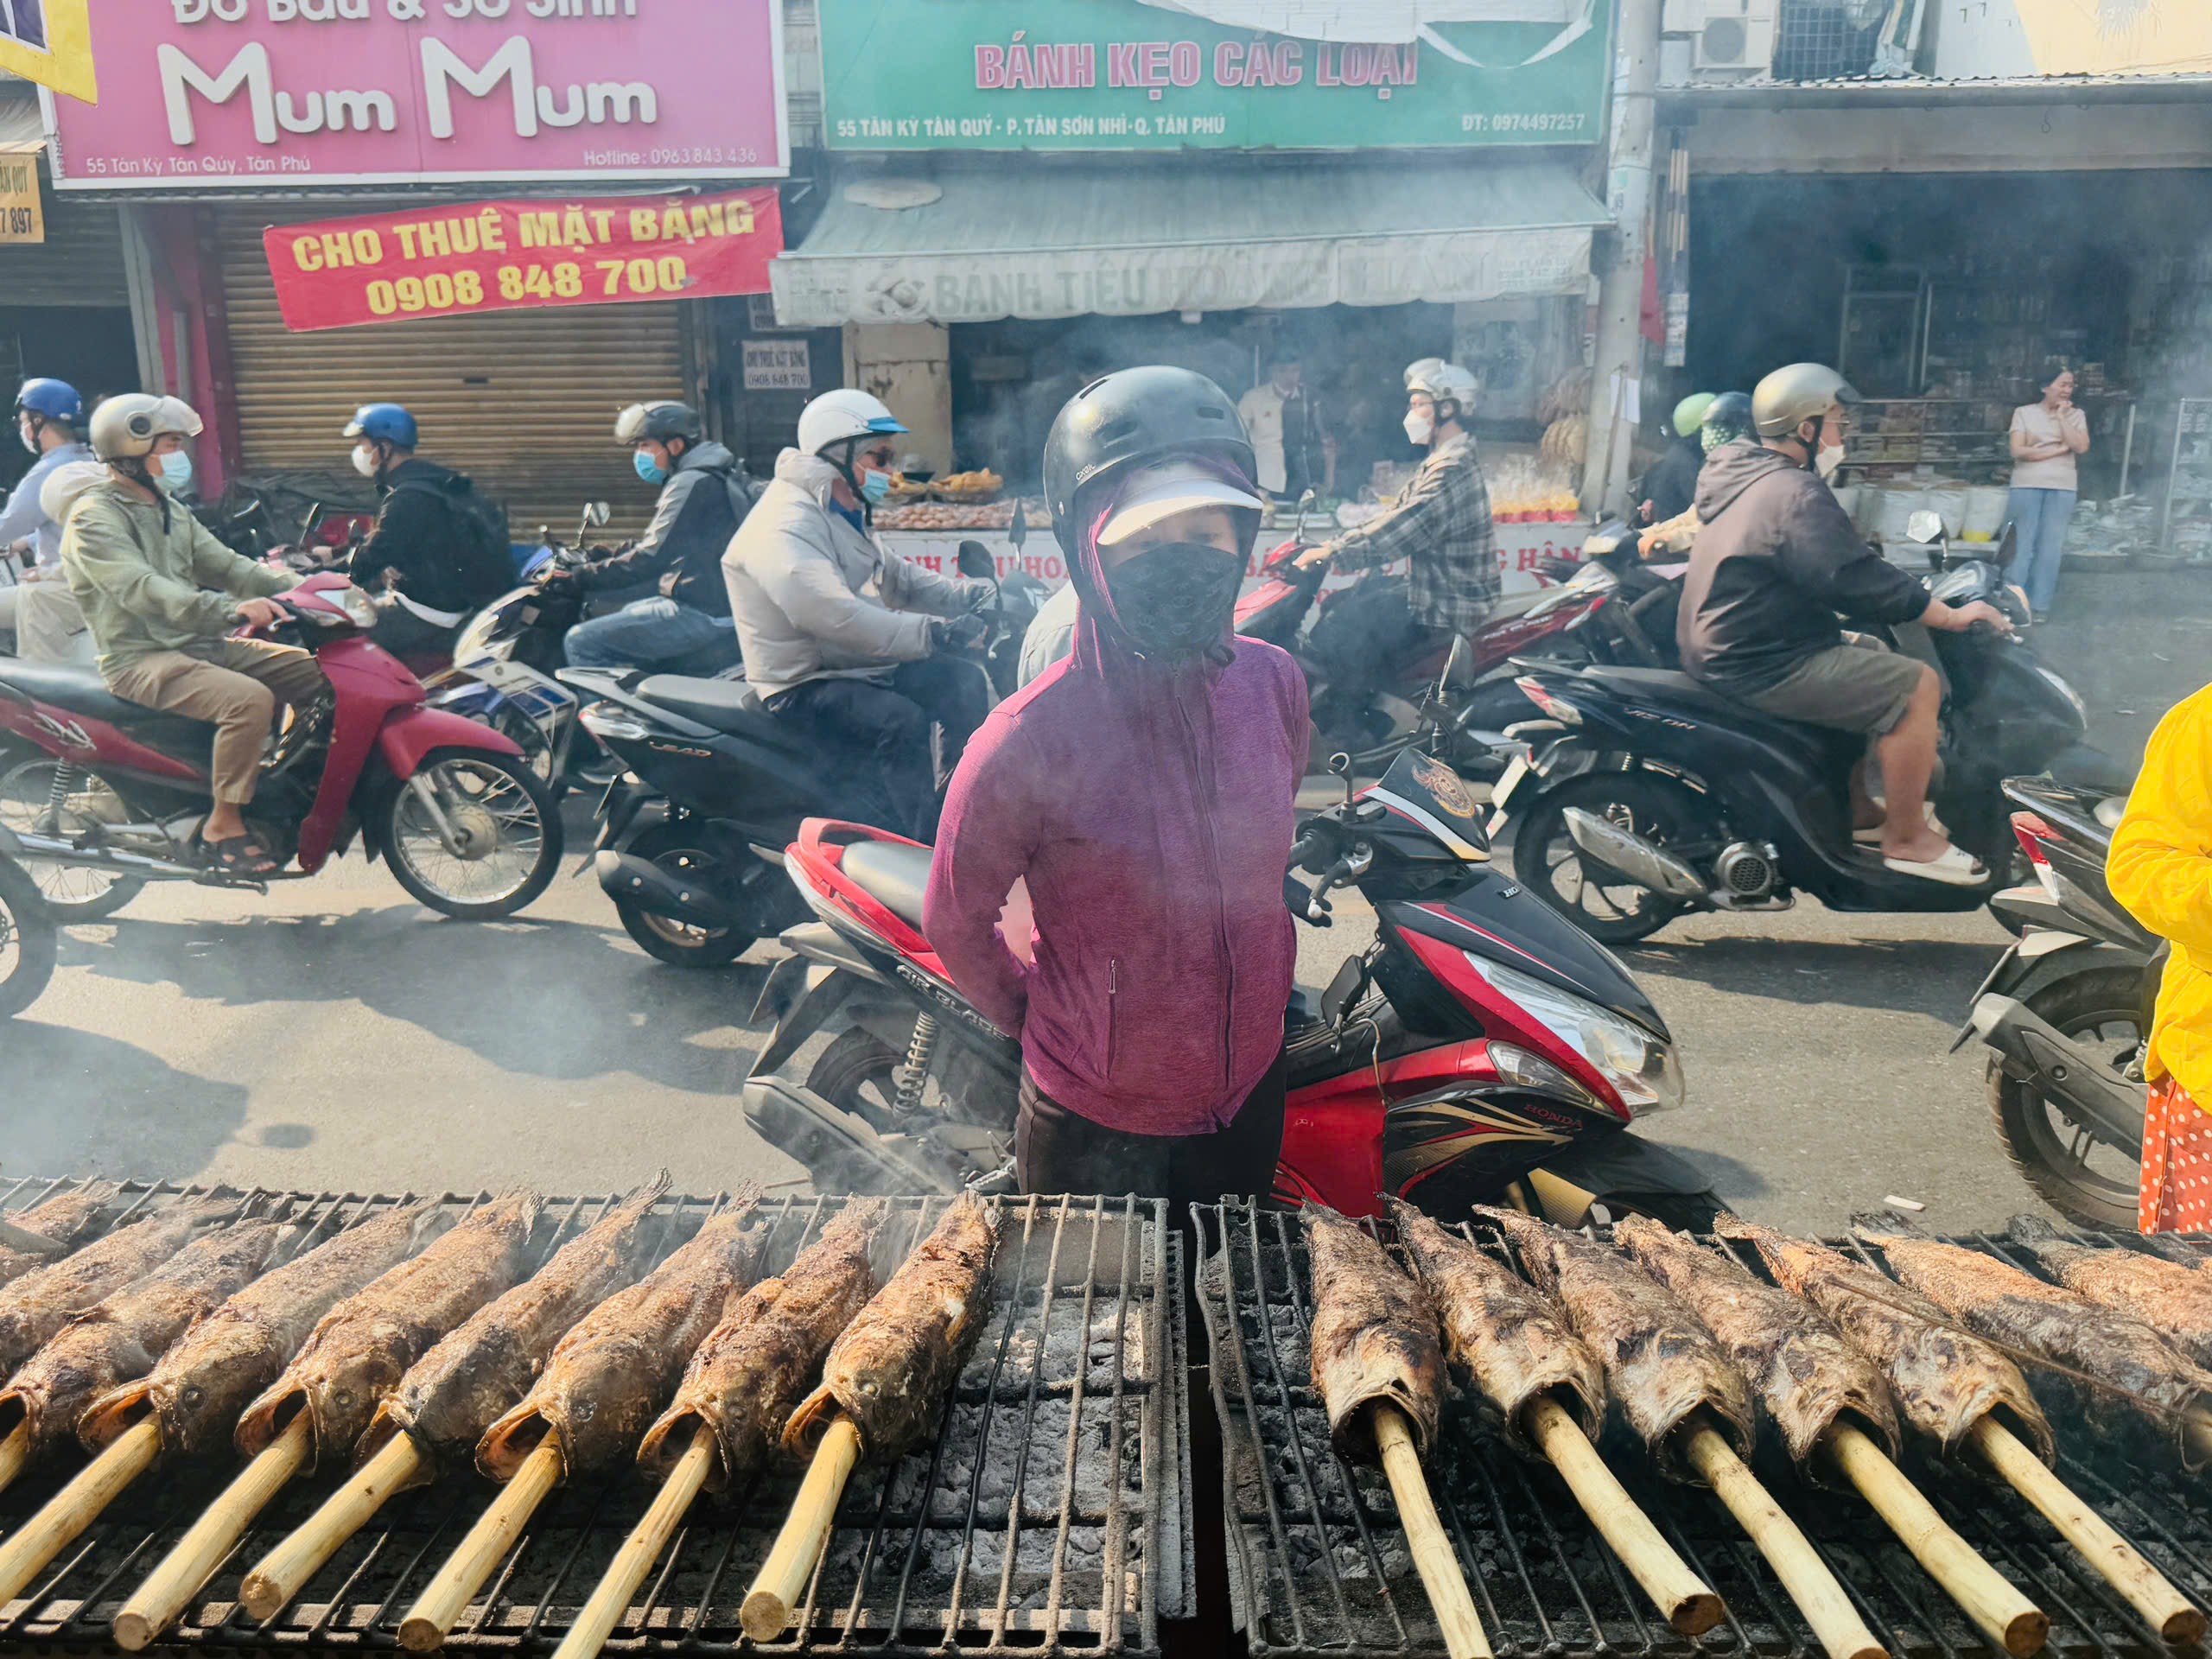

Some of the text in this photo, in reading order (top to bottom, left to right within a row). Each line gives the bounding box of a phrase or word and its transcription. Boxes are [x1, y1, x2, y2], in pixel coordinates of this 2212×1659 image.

[975, 29, 1418, 100] BÁNH KẸO CÁC LOẠI
[156, 35, 657, 145] Mum Mum
[837, 118, 856, 137] 55
[1492, 113, 1586, 130] 0974497257
[86, 157, 106, 173] 55
[281, 154, 311, 171] Phú
[583, 149, 645, 166] Hotline:
[10, 207, 32, 233] 897
[292, 229, 383, 271] CHO
[392, 207, 506, 259] THUÊ
[518, 204, 615, 253] MẶT
[366, 256, 688, 315] 0908 848 700
[934, 263, 1043, 315] BÁNH
[1523, 1103, 1588, 1131] HONDA
